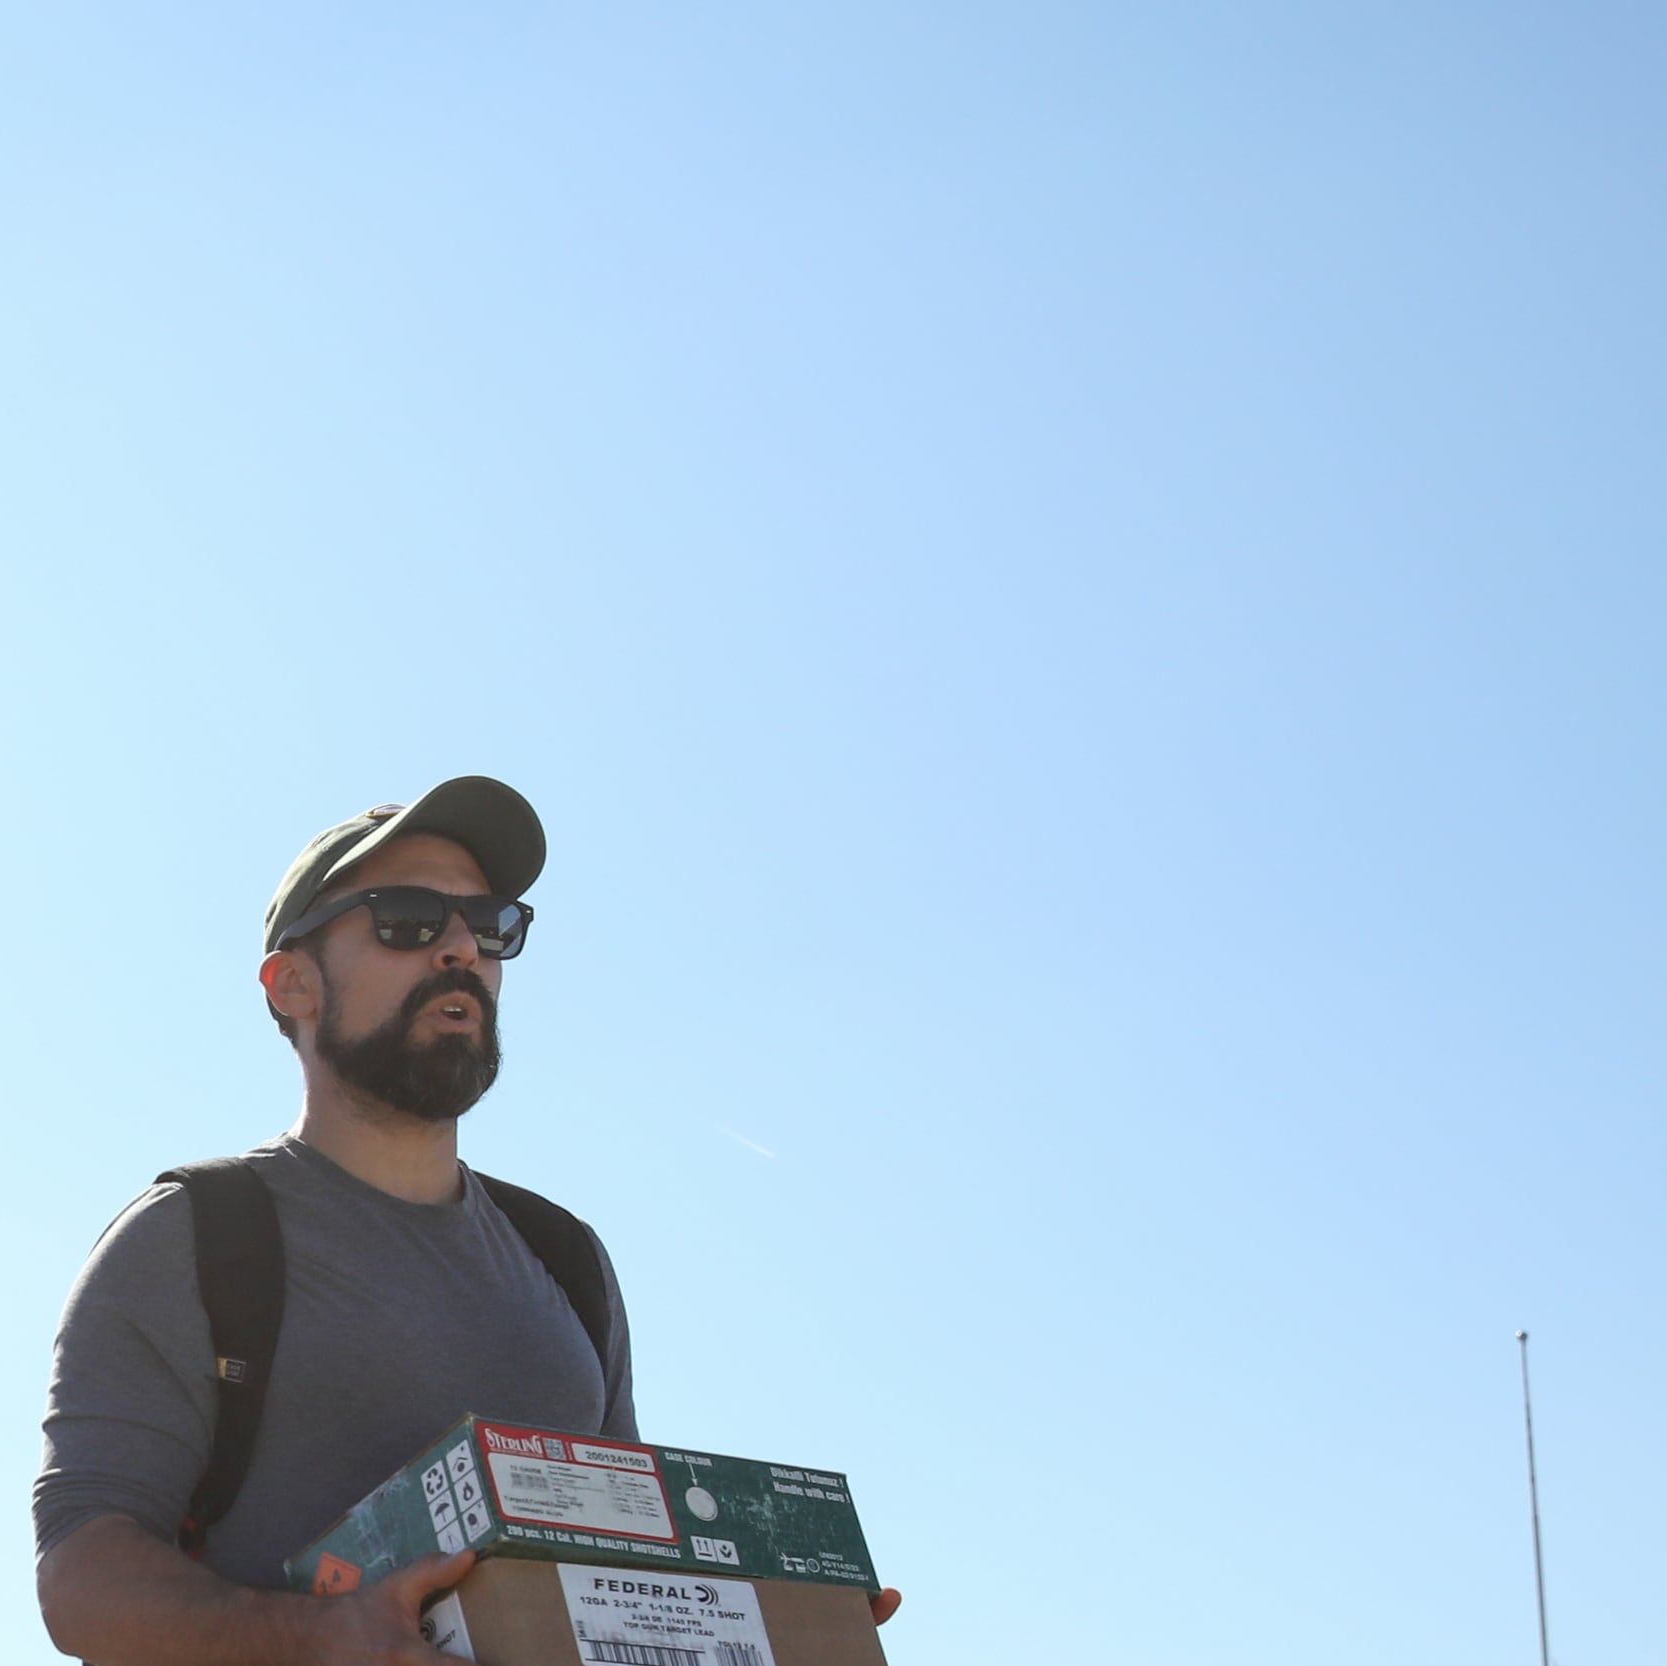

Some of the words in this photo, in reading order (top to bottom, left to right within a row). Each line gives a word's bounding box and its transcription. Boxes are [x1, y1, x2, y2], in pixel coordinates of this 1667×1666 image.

[485, 1428, 543, 1454] STERLING
[773, 1481, 804, 1496] Handle
[804, 1487, 825, 1500] with
[543, 1530, 555, 1541] 12
[573, 1534, 595, 1546] HIGH
[595, 1537, 629, 1551] QUALITY
[630, 1541, 681, 1559] SHOTSHELLS
[594, 1578, 691, 1600] FEDERAL
[580, 1596, 608, 1607] 12GA
[676, 1606, 693, 1615] OZ.
[699, 1608, 715, 1617] 7.5
[718, 1611, 746, 1621] SHOT
[694, 1629, 715, 1637] LEAD
